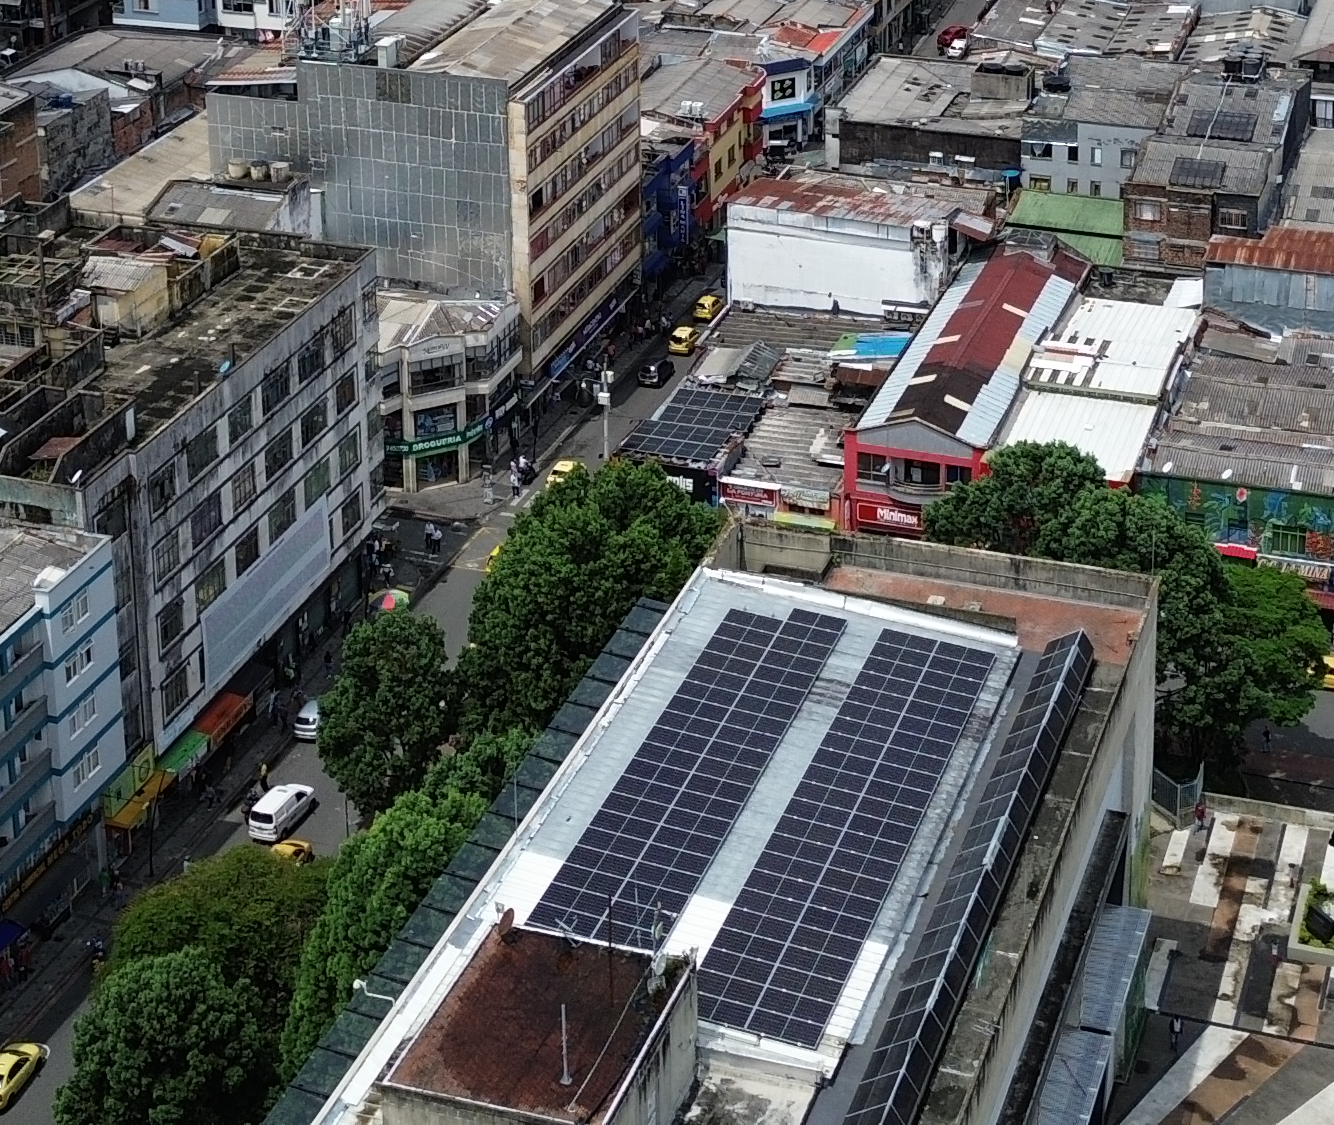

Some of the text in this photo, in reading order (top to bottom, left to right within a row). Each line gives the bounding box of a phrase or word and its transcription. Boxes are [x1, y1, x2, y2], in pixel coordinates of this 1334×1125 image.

[412, 435, 462, 452] DROGUERIA
[737, 490, 769, 499] FORTUNA
[877, 507, 919, 527] Minimax
[1300, 565, 1332, 580] MINA
[47, 838, 70, 866] MEGA
[73, 814, 93, 840] TODO
